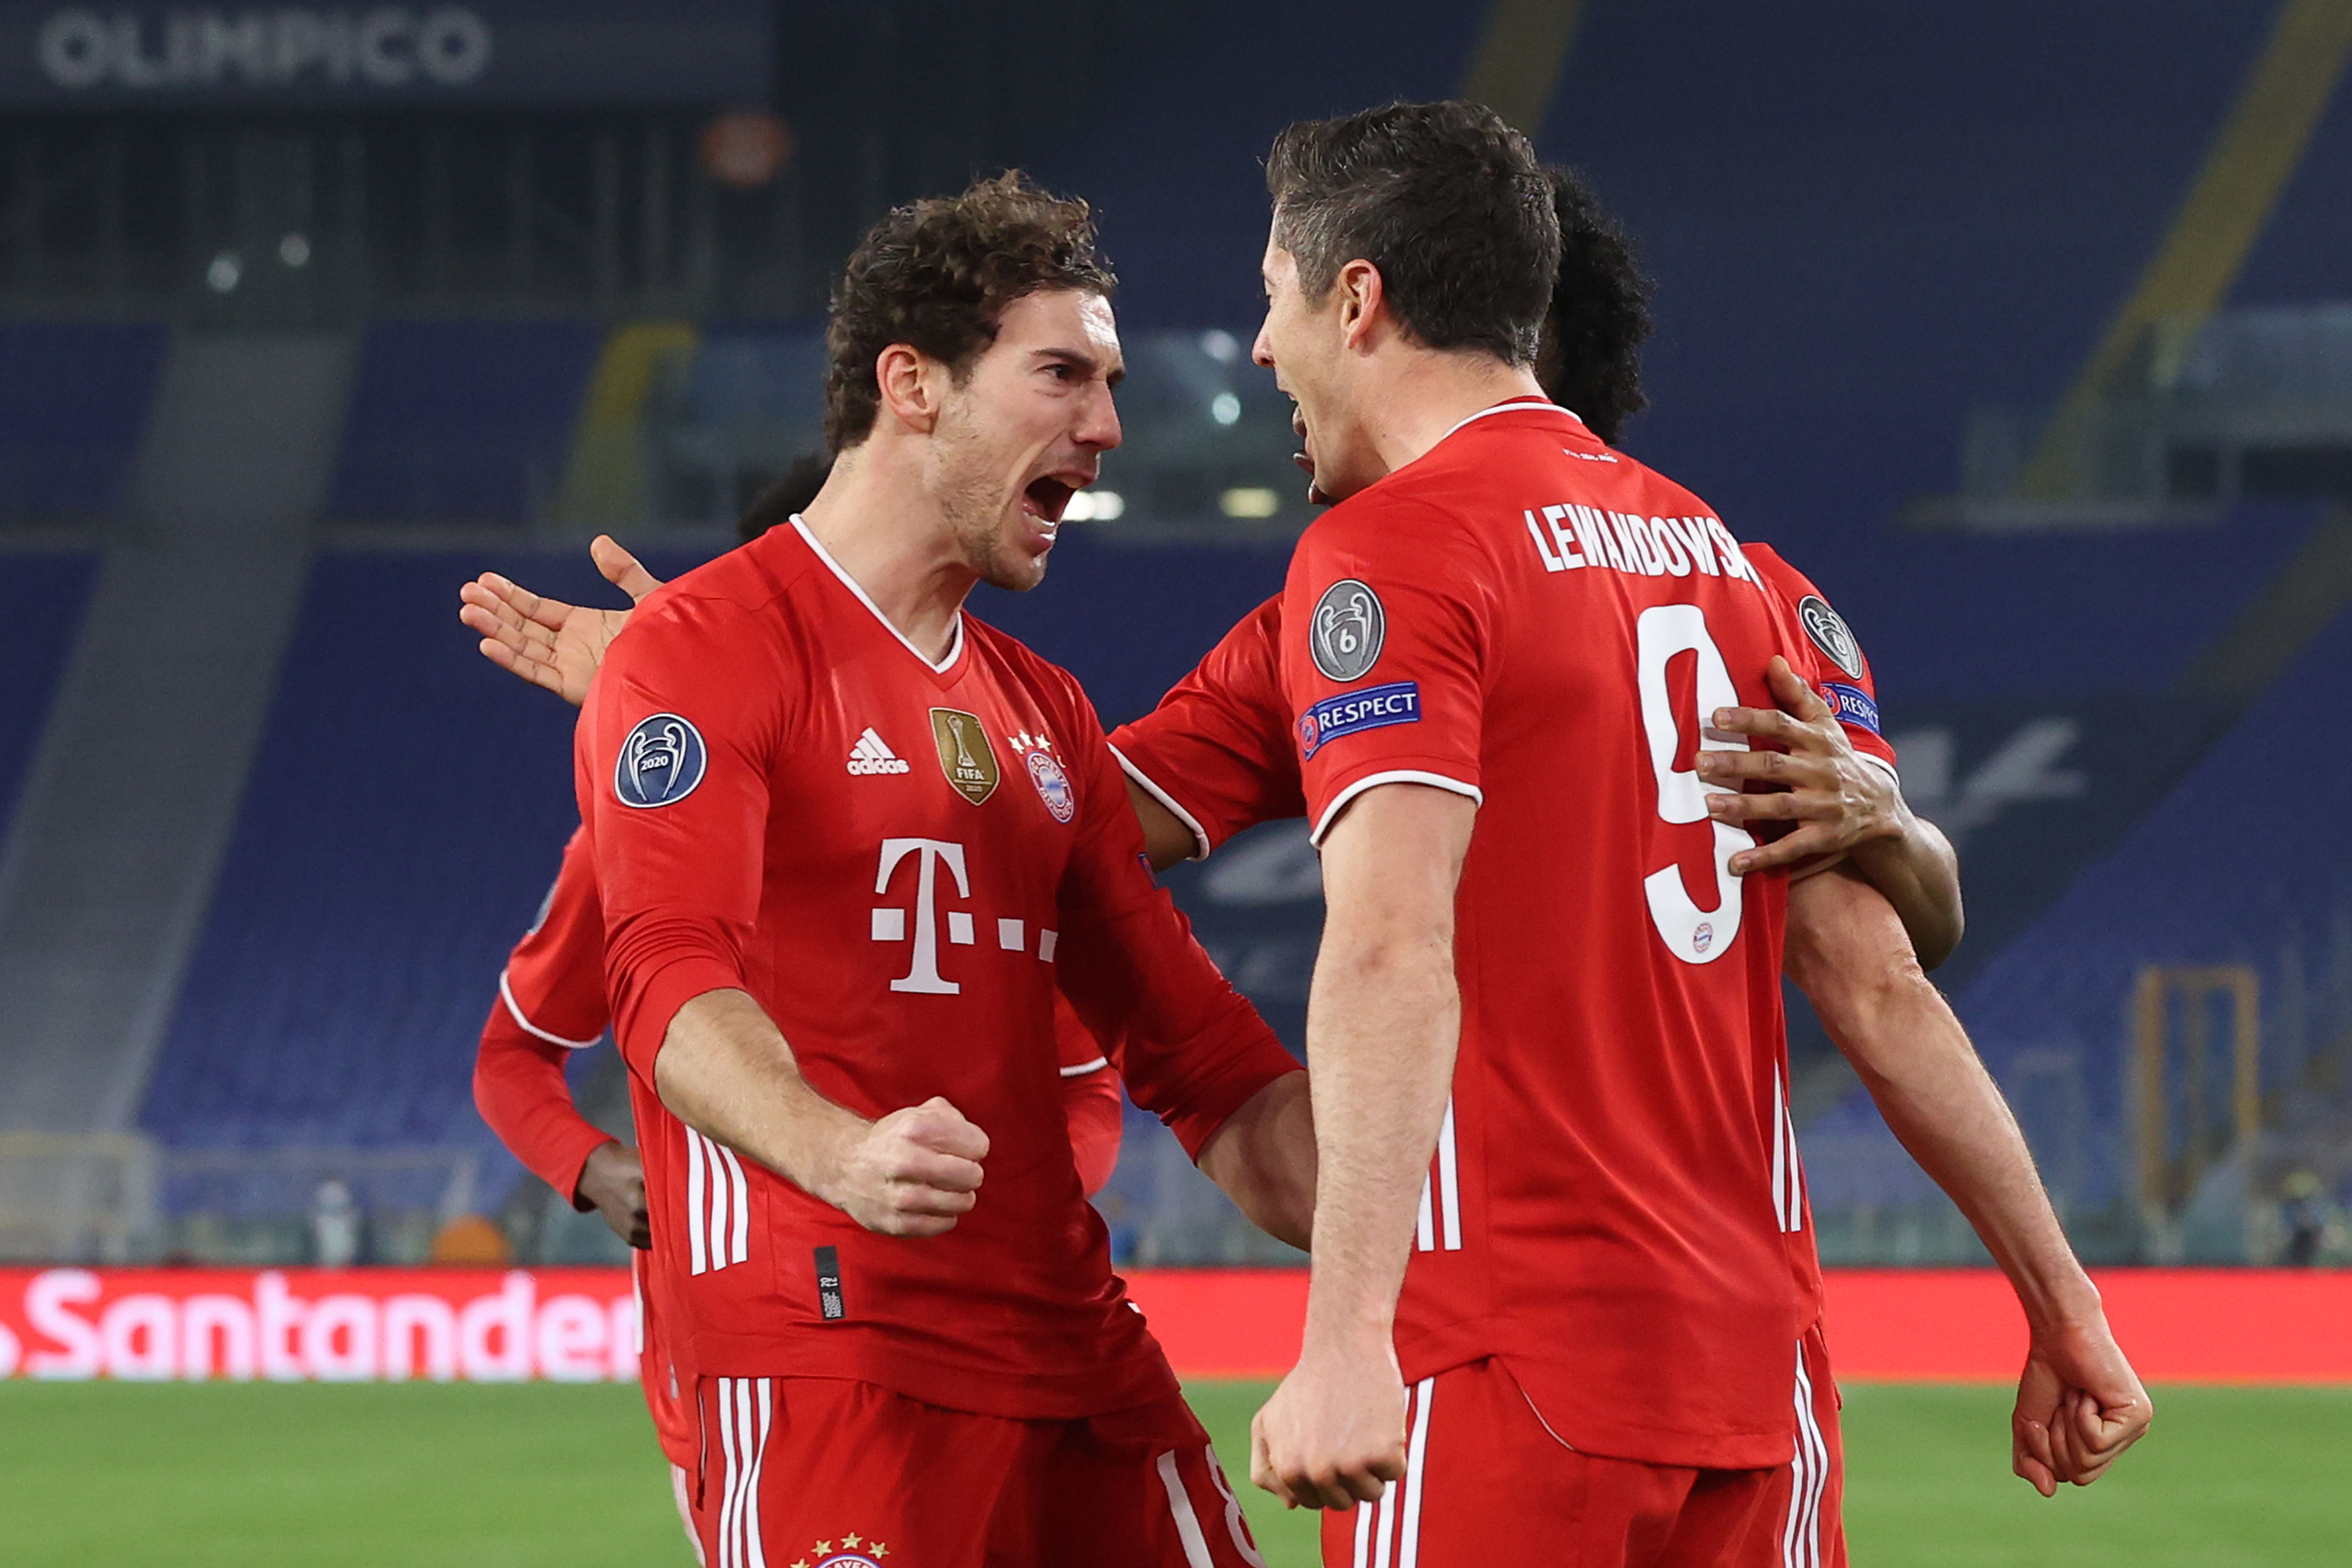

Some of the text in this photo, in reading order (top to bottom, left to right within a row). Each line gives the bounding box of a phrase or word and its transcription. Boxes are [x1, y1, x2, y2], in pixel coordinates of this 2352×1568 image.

[40, 7, 494, 87] OLIMPICO
[1524, 503, 1766, 592] LEWANDOWSK
[1339, 628, 1358, 653] 6
[1318, 693, 1416, 732] RESPECT
[1840, 695, 1879, 729] RESPECT
[641, 755, 669, 771] 2020
[847, 757, 910, 775] adidas
[956, 767, 985, 780] FIFA
[1637, 604, 1755, 964] 9
[871, 838, 975, 995] T
[23, 1269, 638, 1382] Santander
[1157, 1444, 1267, 1568] 18
